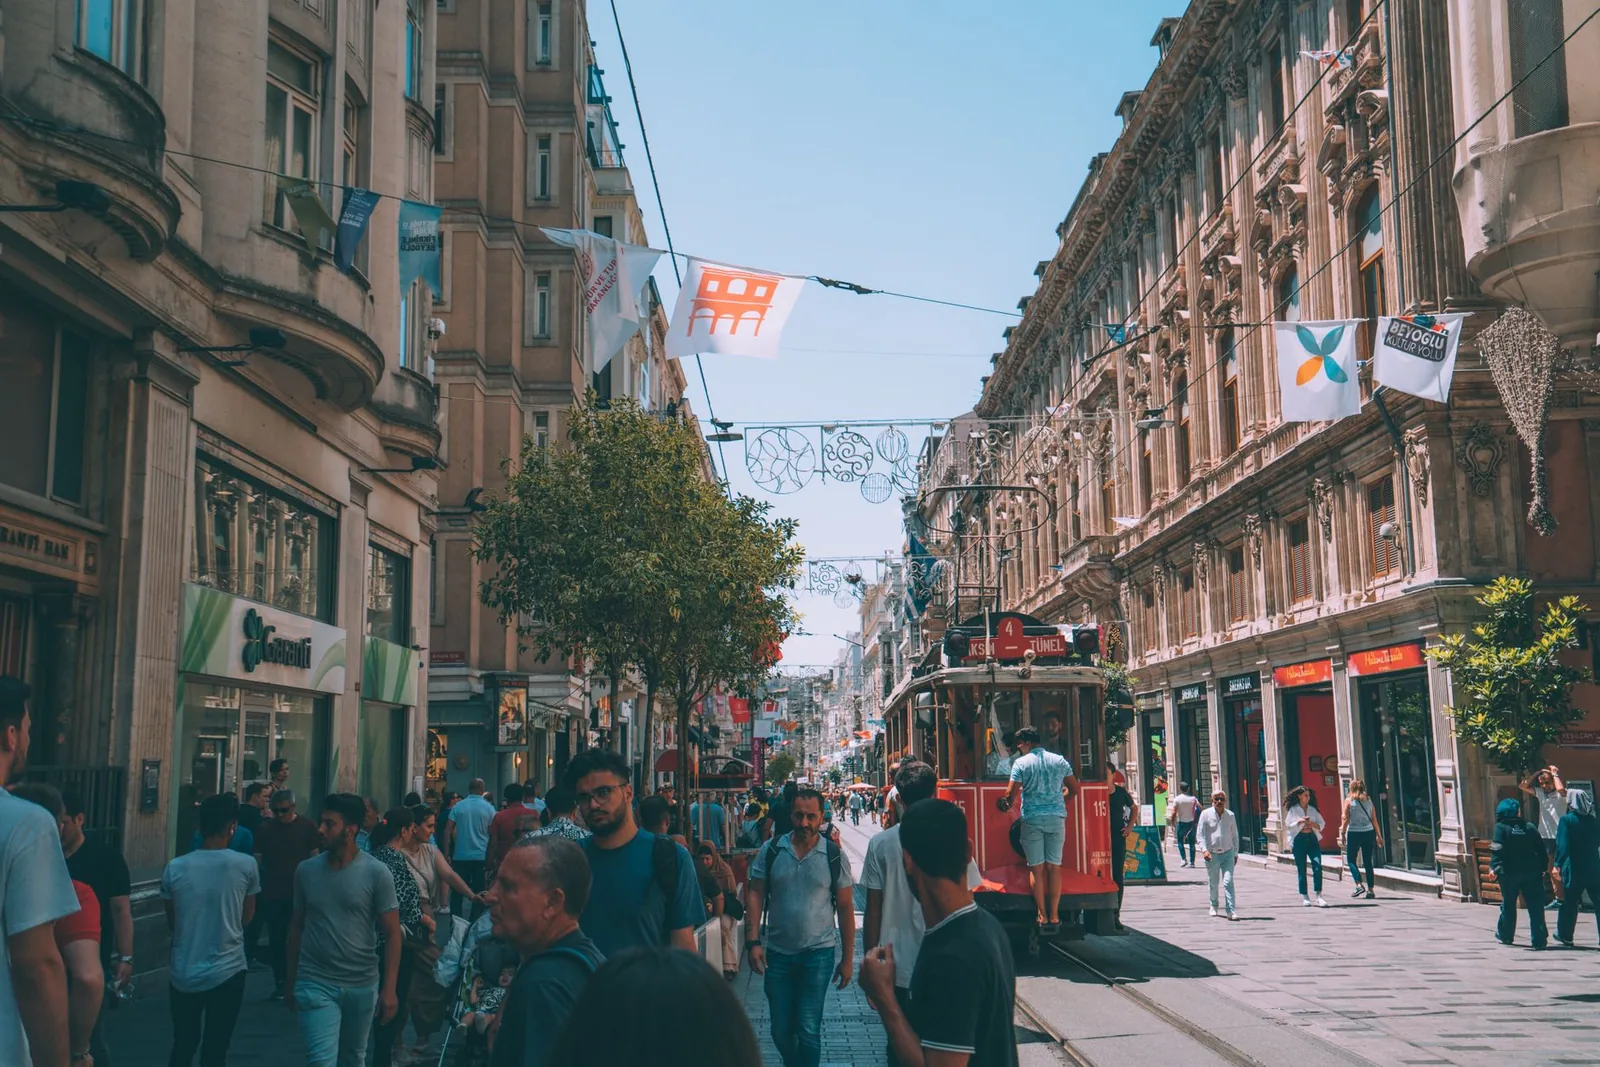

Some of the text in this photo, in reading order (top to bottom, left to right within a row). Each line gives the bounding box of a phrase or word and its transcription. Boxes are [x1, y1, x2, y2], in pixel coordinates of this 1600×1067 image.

[1418, 346, 1443, 360] YOLU
[1005, 621, 1013, 636] 4
[261, 625, 312, 669] Garanti
[1029, 638, 1064, 653] TÜNEL
[1093, 800, 1107, 817] 115
